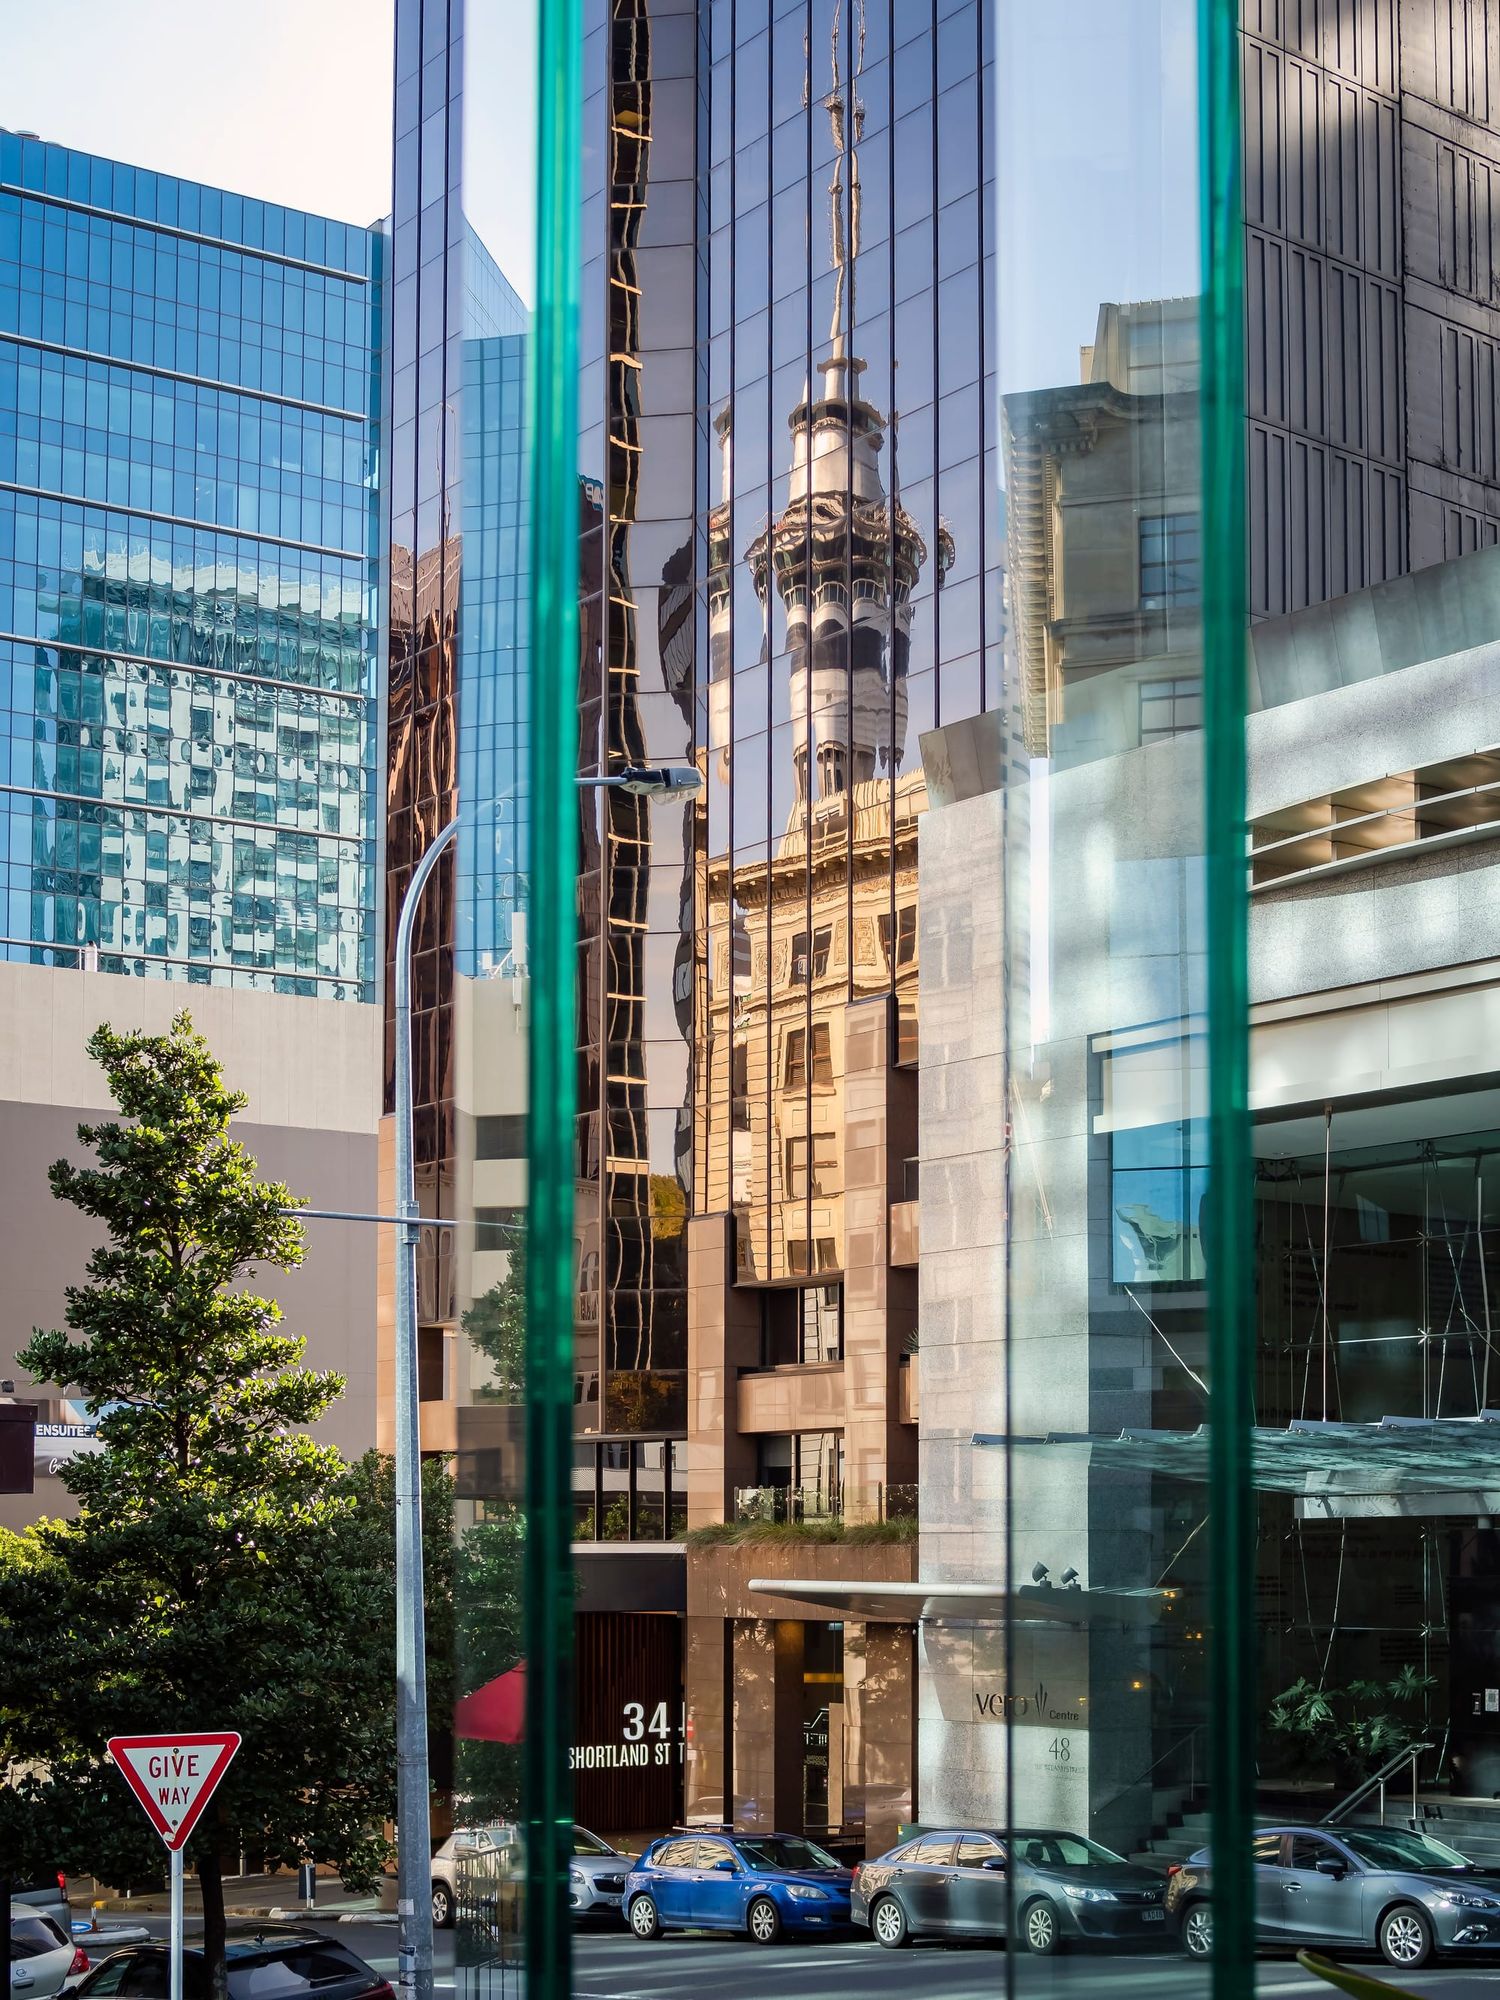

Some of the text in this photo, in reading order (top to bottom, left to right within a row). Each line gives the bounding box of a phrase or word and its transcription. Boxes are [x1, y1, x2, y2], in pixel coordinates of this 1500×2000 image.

[622, 1702, 671, 1741] 34
[1049, 1709, 1080, 1721] Centre
[568, 1742, 671, 1769] SHORTLAND ST
[1048, 1737, 1071, 1761] 48
[148, 1754, 200, 1779] GIVE
[158, 1786, 190, 1806] WAY
